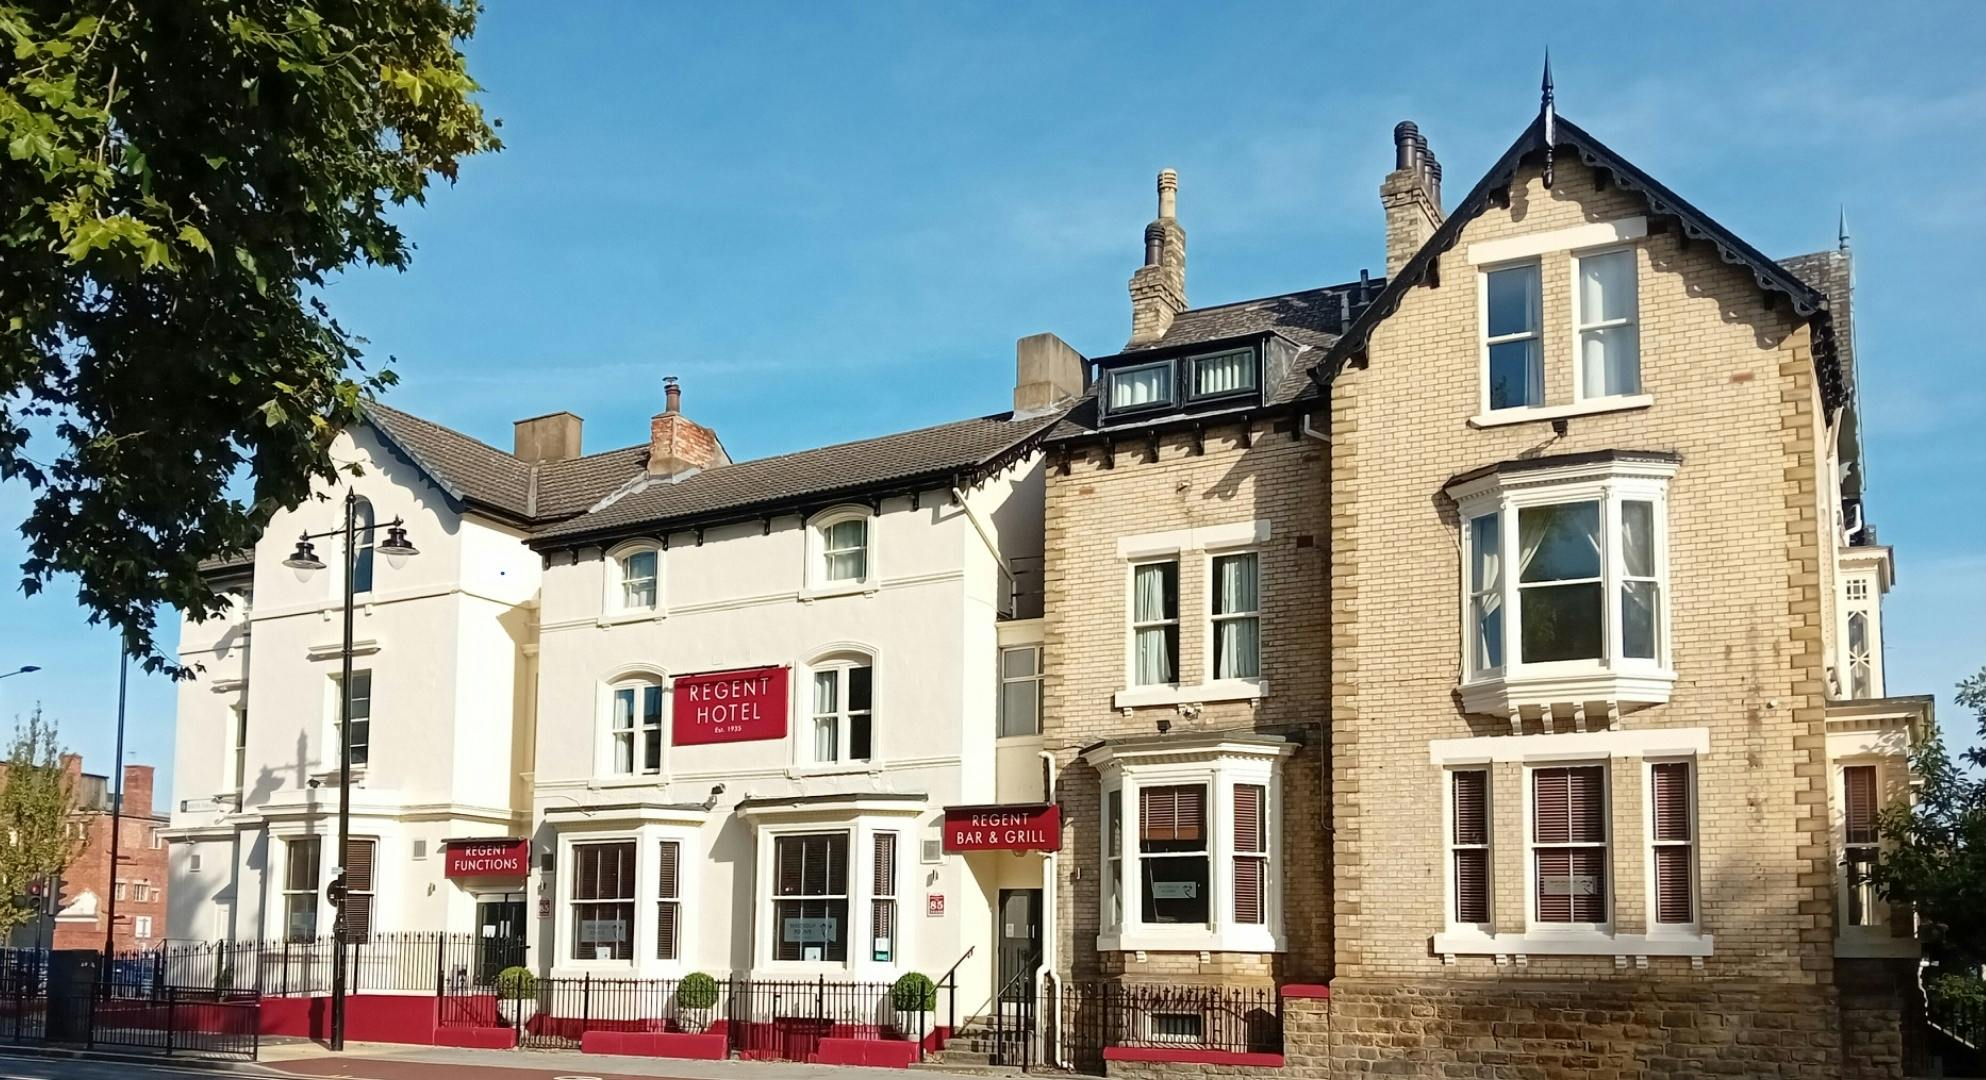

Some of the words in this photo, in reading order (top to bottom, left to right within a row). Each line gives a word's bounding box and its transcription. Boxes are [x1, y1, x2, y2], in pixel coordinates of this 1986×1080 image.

[689, 677, 769, 702] REGENT
[697, 702, 761, 724] HOTEL
[714, 726, 724, 734] Est.
[972, 812, 1029, 827] REGENT
[956, 831, 983, 845] BAR
[988, 831, 998, 844] &
[1004, 830, 1045, 844] GRILL
[465, 844, 507, 857] REGENT
[454, 858, 518, 871] FUNCTIONS
